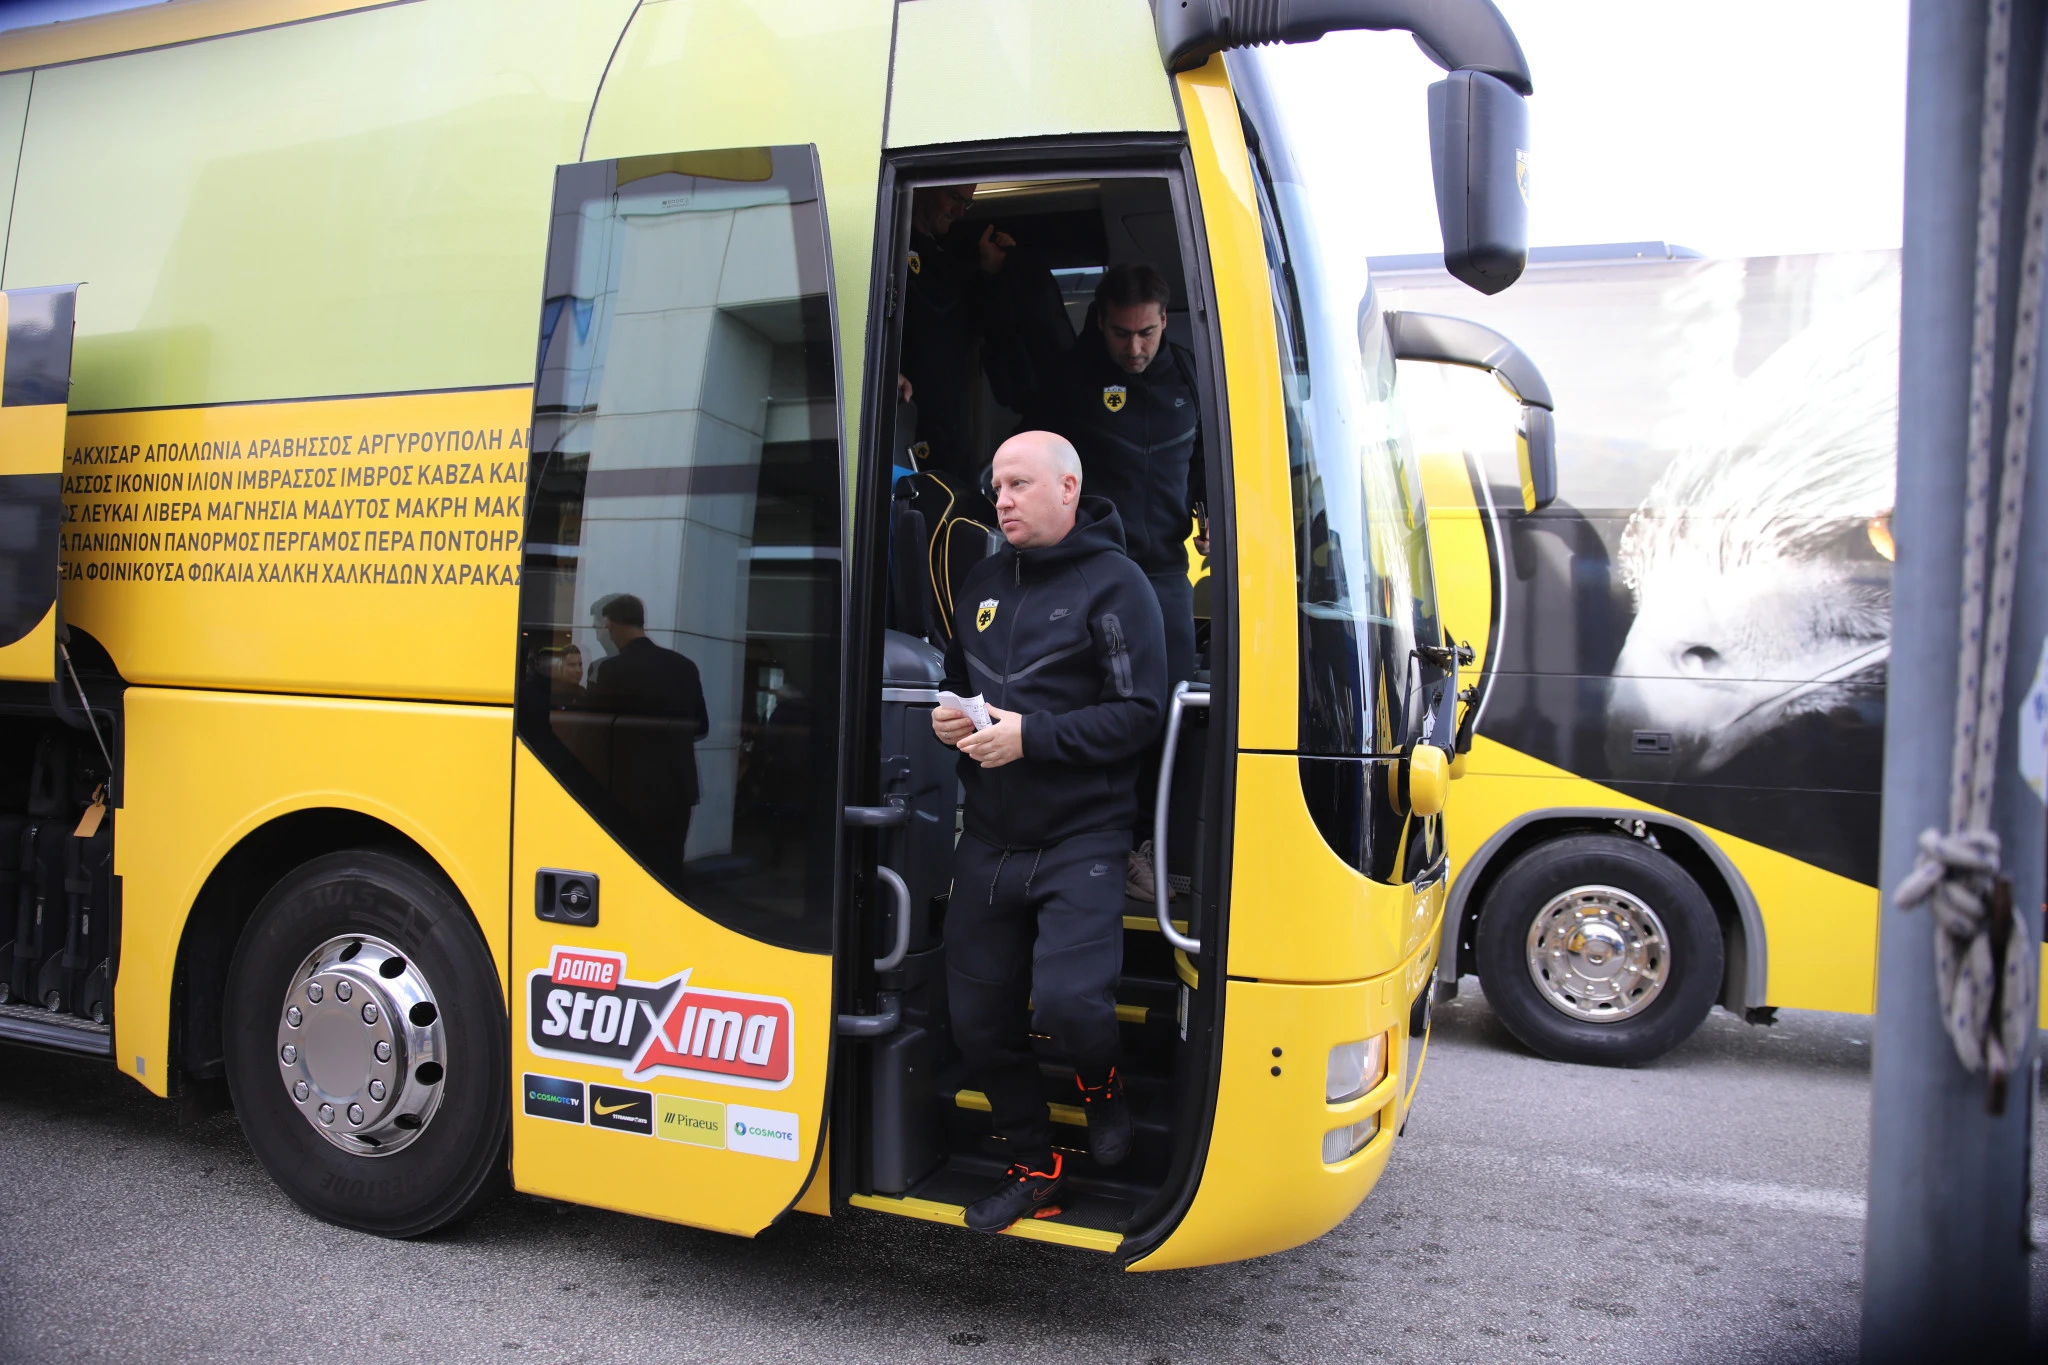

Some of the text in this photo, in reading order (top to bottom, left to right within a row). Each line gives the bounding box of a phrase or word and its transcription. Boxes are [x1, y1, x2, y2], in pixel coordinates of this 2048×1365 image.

[145, 441, 242, 462] ΑΠΟΛΛΩΝΙΑ
[247, 435, 352, 459] ΑΡΑΒΗΣΣΟΣ
[357, 429, 503, 454] ΑΡΓΥΡΟΥΠΟΛΗ
[116, 472, 183, 493] ΙΚΟΝΙΟΝ
[188, 471, 232, 492] ΙΛΙΟΝ
[237, 467, 337, 489] ΙΜΒΡΑΣΣΟΣ
[340, 465, 413, 487] ΙΜΒΡΟΣ
[418, 463, 484, 485] ΚΑΒΖΑ
[81, 503, 138, 522] ΛΕΥΚΑΙ
[142, 502, 202, 521] ΛΙΒΕΡΑ
[207, 500, 297, 520] ΜΑΓΝΗΣΙΑ
[303, 498, 390, 519] ΜΑΔΥΤΟΣ
[395, 496, 467, 518] ΜΑΚΡΗ
[474, 495, 525, 517] ΜΑΚ
[71, 532, 160, 551] ΠΑΝΙΩΝΙΟΝ
[165, 532, 260, 551] ΠΑΝΟΡΜΟΣ
[264, 531, 361, 551] ΠΕΡΓΑΜΟΣ
[364, 530, 415, 551] ΠΕΡΑ
[86, 562, 185, 581] ΦΟΙΝΙΚΟΥΣΑ
[188, 562, 254, 582] ΦΩΚΑΙΑ
[257, 563, 318, 583] ΧΑΛΚΗ
[322, 563, 428, 584] ΧΑΛΚΗΔΩΝ
[557, 957, 614, 984] pame
[536, 1093, 571, 1105] COSMOTE
[677, 1113, 719, 1131] Piraeus
[748, 1127, 793, 1141] COSMOTE
